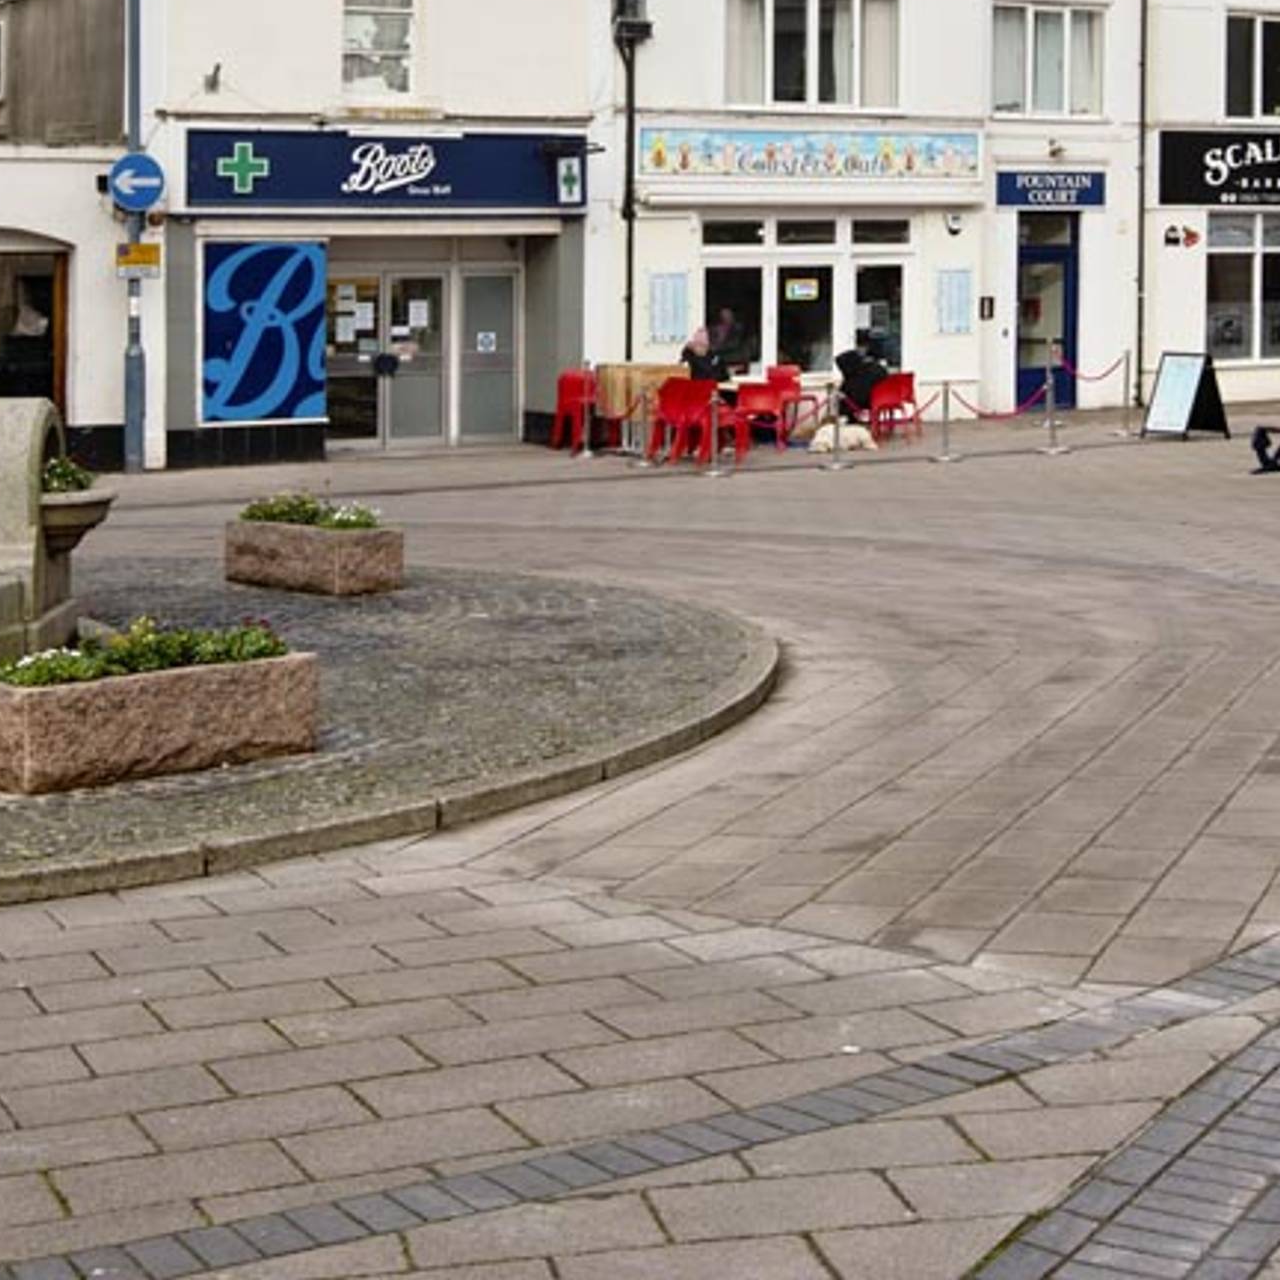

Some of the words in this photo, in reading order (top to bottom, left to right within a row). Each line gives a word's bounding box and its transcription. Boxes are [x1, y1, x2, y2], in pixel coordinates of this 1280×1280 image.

[341, 142, 437, 194] Boots
[1016, 174, 1092, 189] FOUNTAIN
[1028, 189, 1077, 203] COURT
